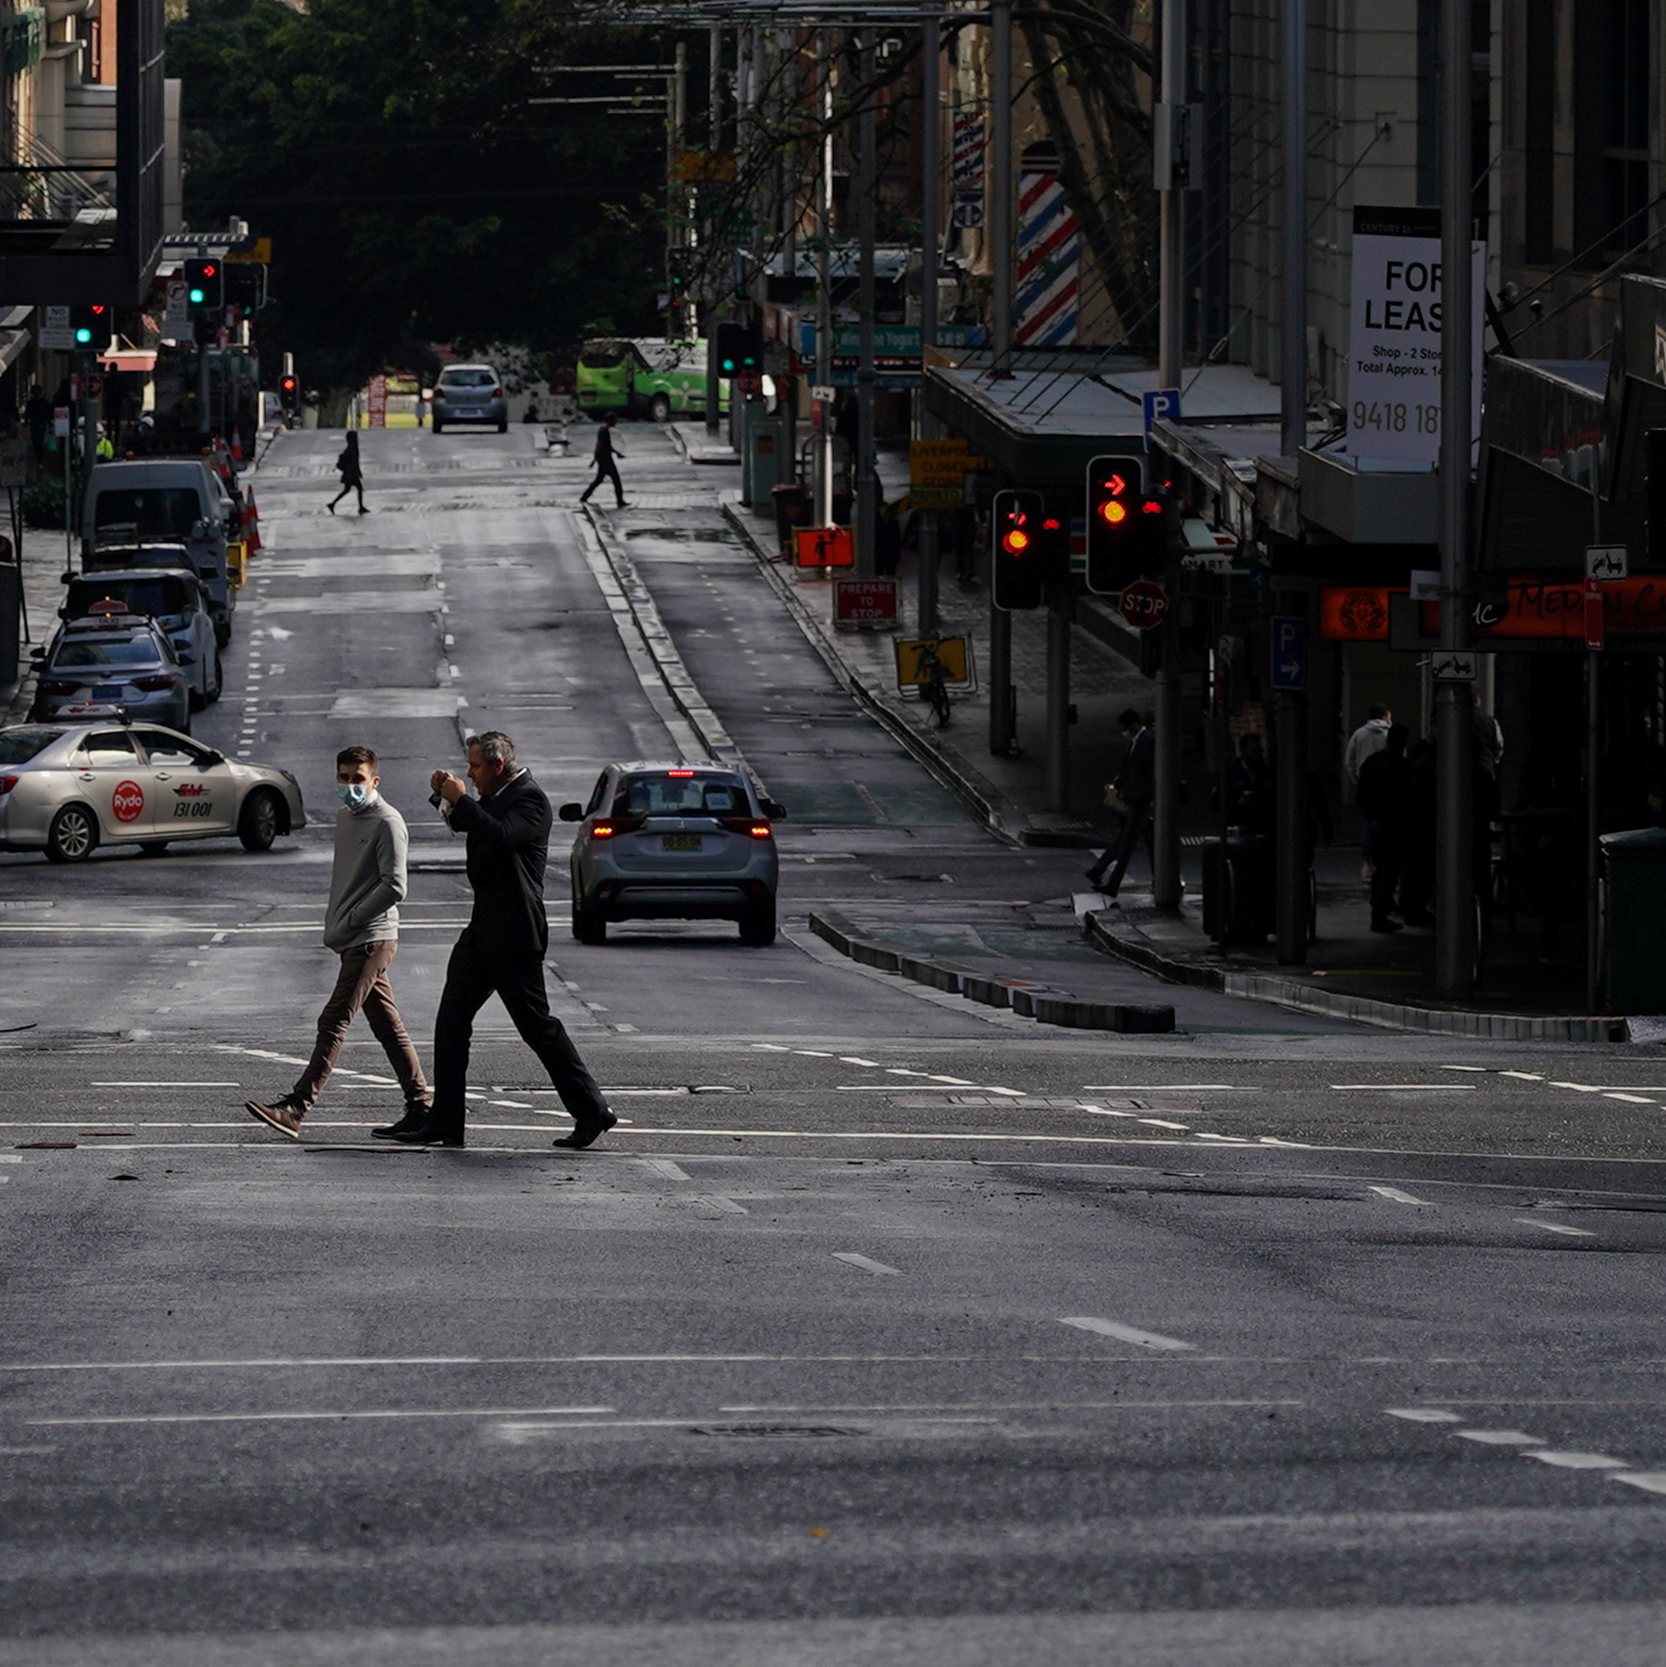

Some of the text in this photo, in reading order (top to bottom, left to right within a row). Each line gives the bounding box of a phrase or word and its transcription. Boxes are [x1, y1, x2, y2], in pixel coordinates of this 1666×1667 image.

[1385, 260, 1443, 292] FOR
[1365, 298, 1443, 333] LEAS
[1372, 345, 1401, 360] Shop
[1357, 360, 1383, 373] Total
[1386, 364, 1428, 377] Approx.
[1152, 395, 1171, 418] P
[1353, 400, 1407, 432] 9418
[839, 583, 894, 595] PREPARE
[860, 596, 875, 607] TO
[1124, 593, 1166, 615] STOP
[1517, 582, 1622, 620] MEDN
[850, 608, 883, 620] STOP
[1280, 624, 1295, 652] P
[114, 793, 143, 811] Rydo
[173, 802, 213, 817] 131 001
